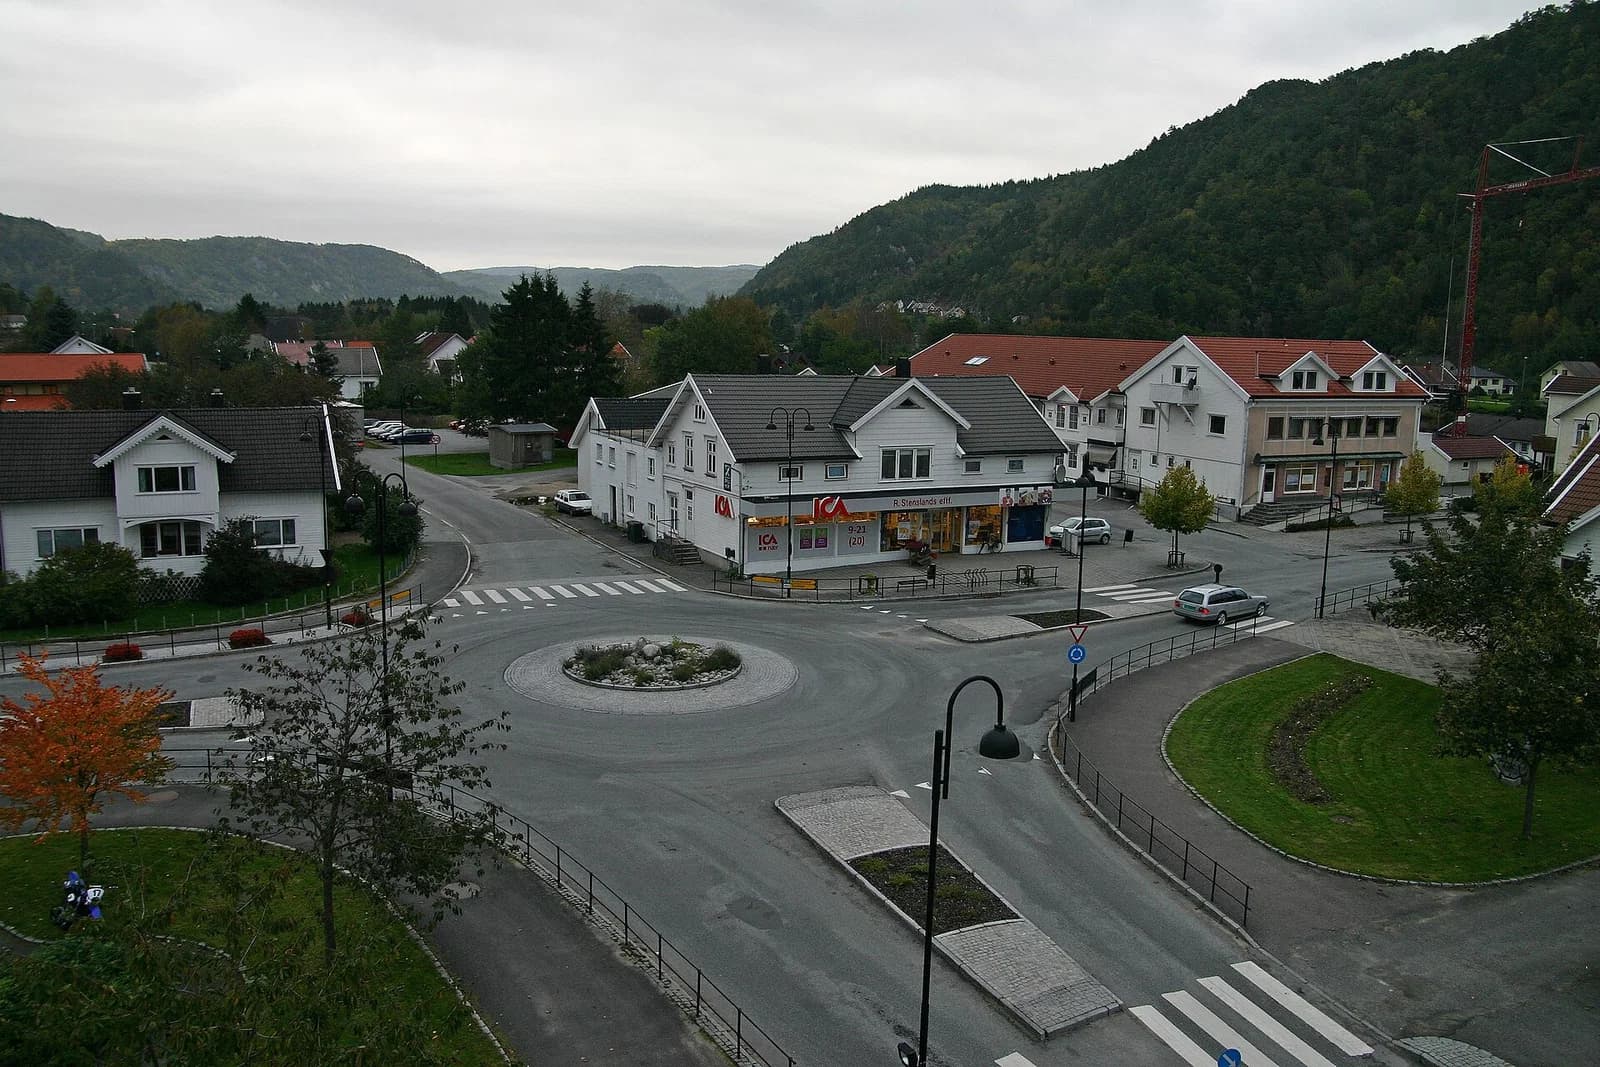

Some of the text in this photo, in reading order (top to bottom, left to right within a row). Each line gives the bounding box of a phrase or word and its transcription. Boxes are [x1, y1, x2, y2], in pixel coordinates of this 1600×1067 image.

[714, 494, 735, 519] ICA
[812, 496, 849, 519] ICA
[758, 534, 778, 546] ICA
